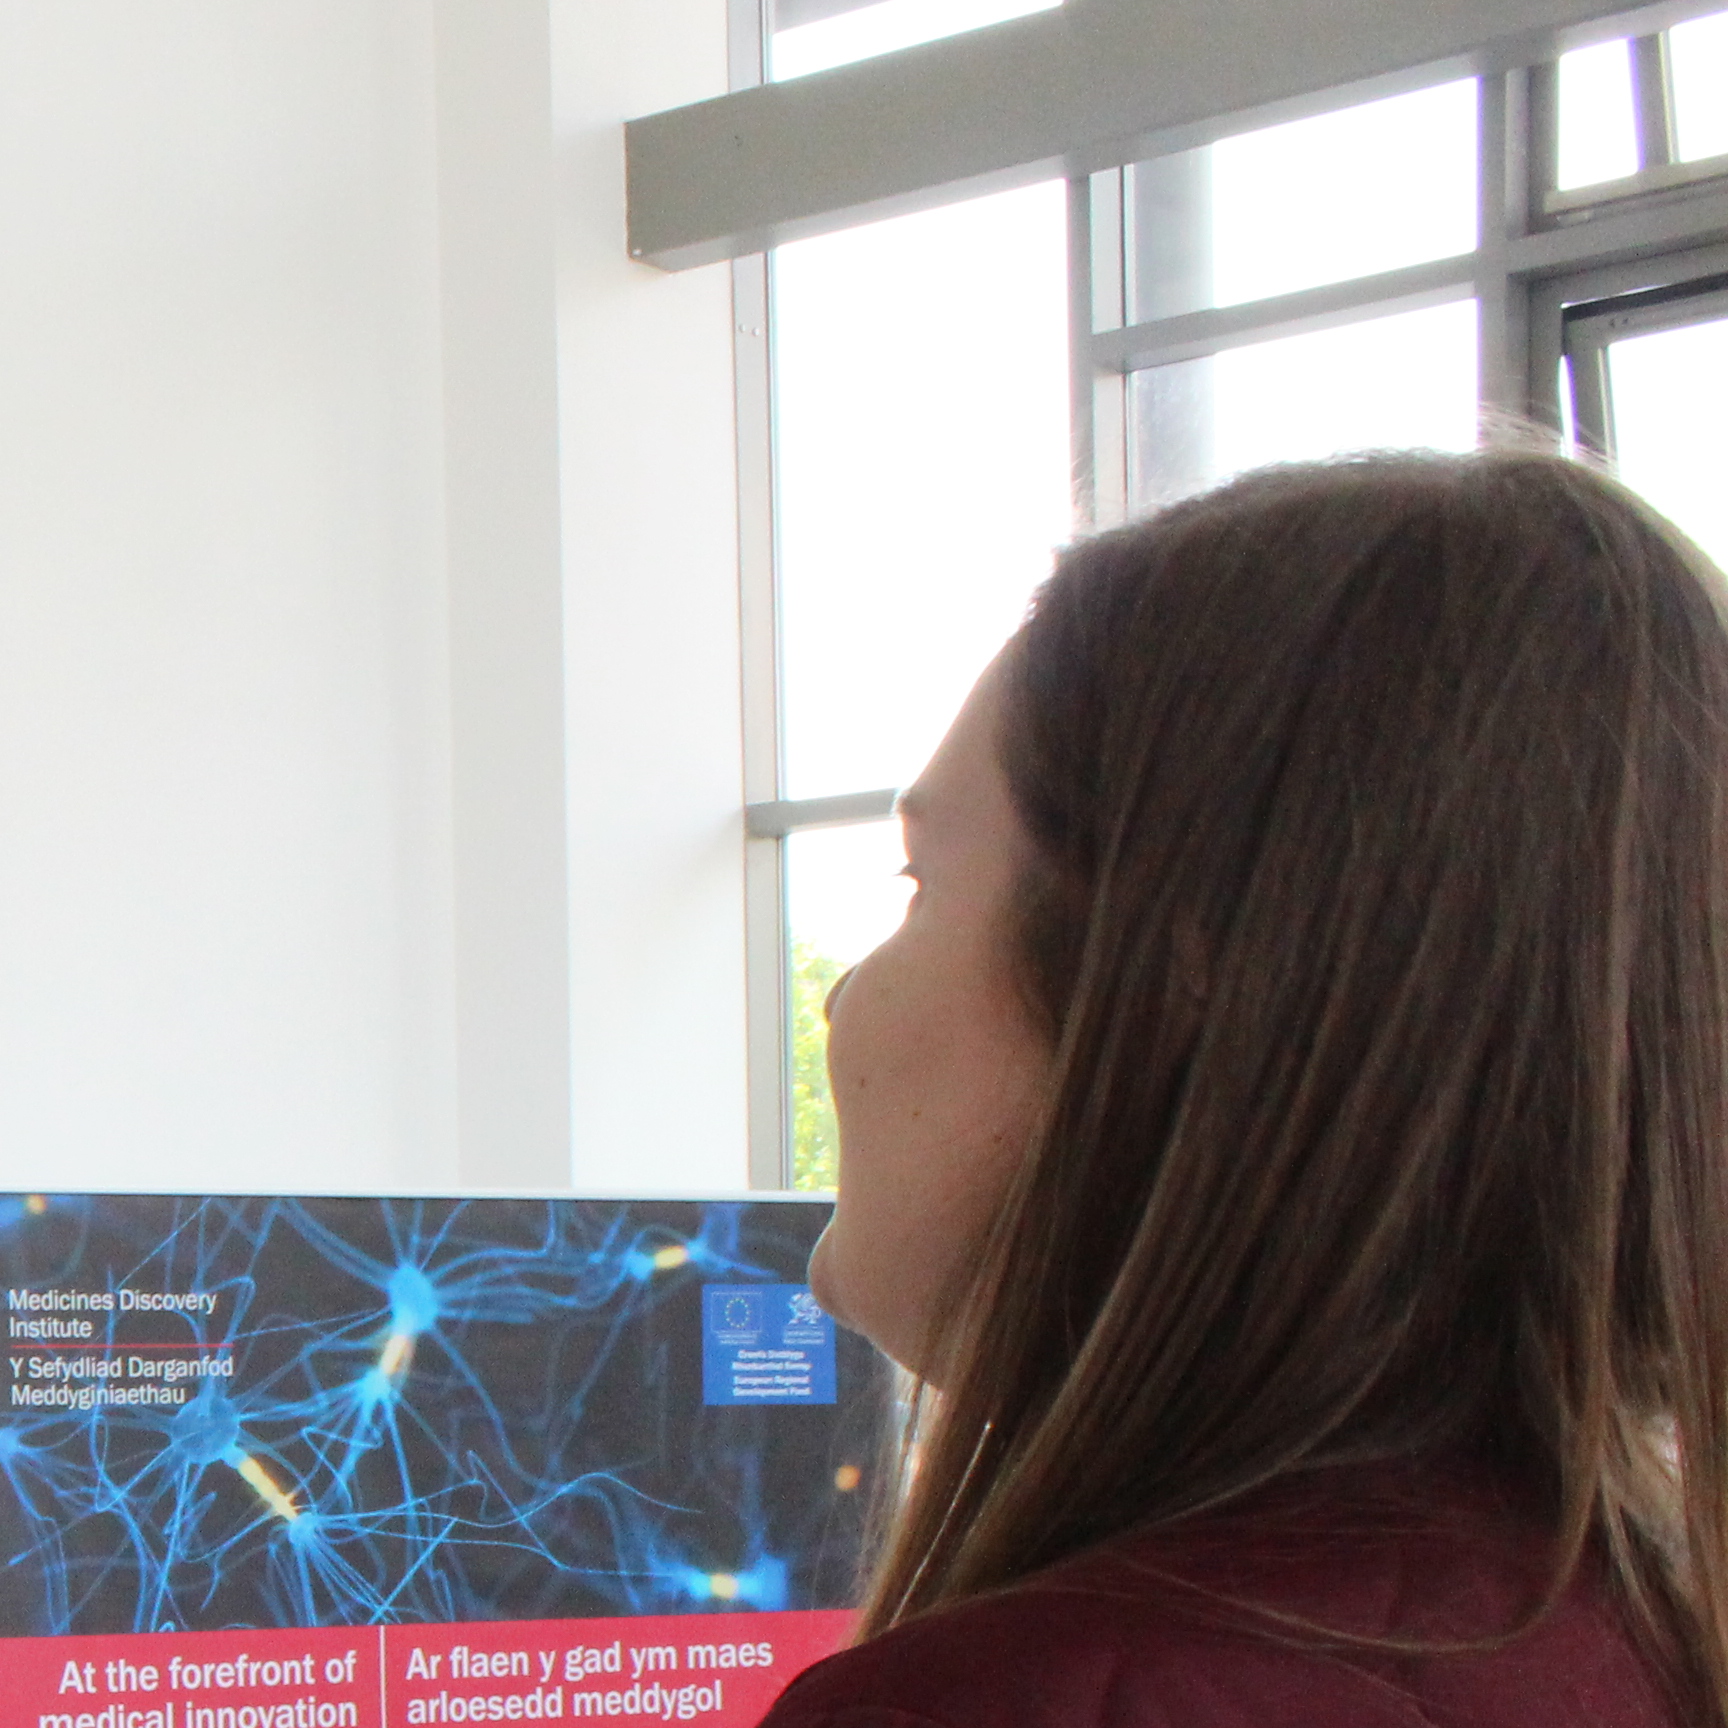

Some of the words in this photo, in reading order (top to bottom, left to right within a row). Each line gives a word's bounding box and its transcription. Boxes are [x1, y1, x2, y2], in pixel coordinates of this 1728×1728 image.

[8, 1288, 115, 1312] Medicines
[119, 1289, 217, 1316] Discovery
[9, 1316, 93, 1339] Institute
[9, 1360, 22, 1378] Y
[28, 1357, 123, 1383] Sefydliad
[127, 1355, 235, 1383] Darganfod
[11, 1385, 186, 1411] Meddyginiaethau
[58, 1659, 97, 1694] At
[105, 1658, 159, 1693] the
[167, 1653, 315, 1690] forefront
[324, 1649, 358, 1685] of
[405, 1646, 442, 1681] Ar
[448, 1644, 530, 1678] flaen
[539, 1651, 556, 1683] y
[564, 1640, 622, 1682] gad
[630, 1646, 678, 1681] ym
[687, 1641, 774, 1669] maes
[406, 1686, 563, 1725] arloesedd
[573, 1679, 723, 1725] meddygol
